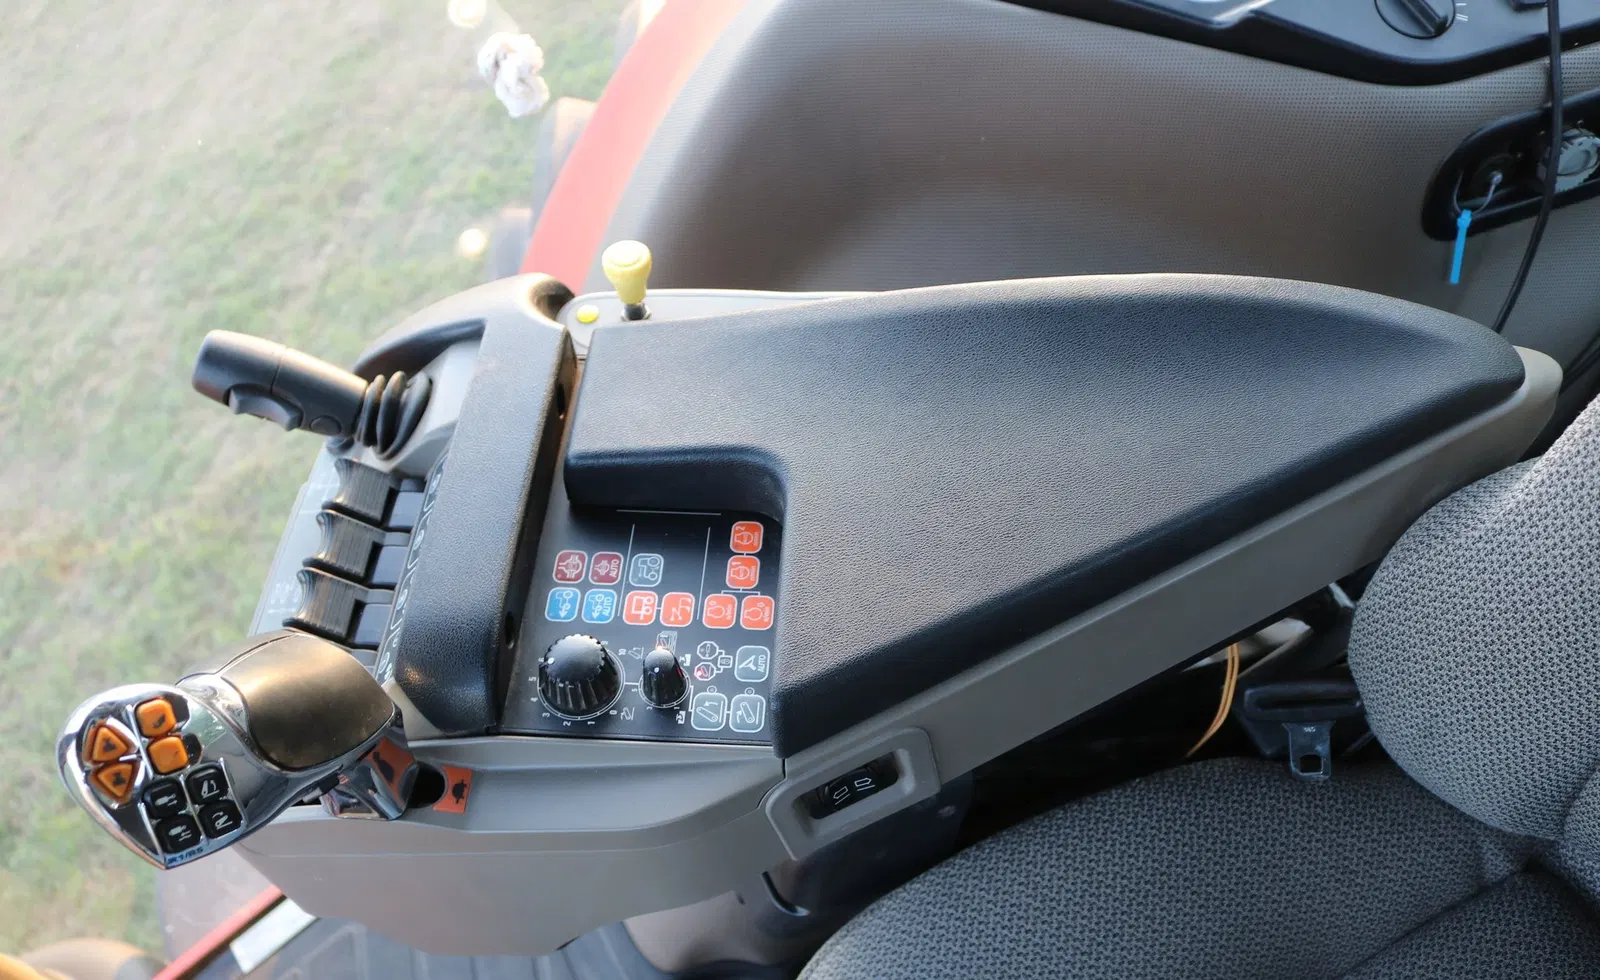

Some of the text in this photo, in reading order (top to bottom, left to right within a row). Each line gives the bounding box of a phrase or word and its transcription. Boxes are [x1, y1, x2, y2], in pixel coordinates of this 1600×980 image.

[609, 559, 620, 578] AUTO
[602, 597, 613, 617] AUTO
[618, 648, 627, 656] 10
[757, 654, 767, 673] AUTO
